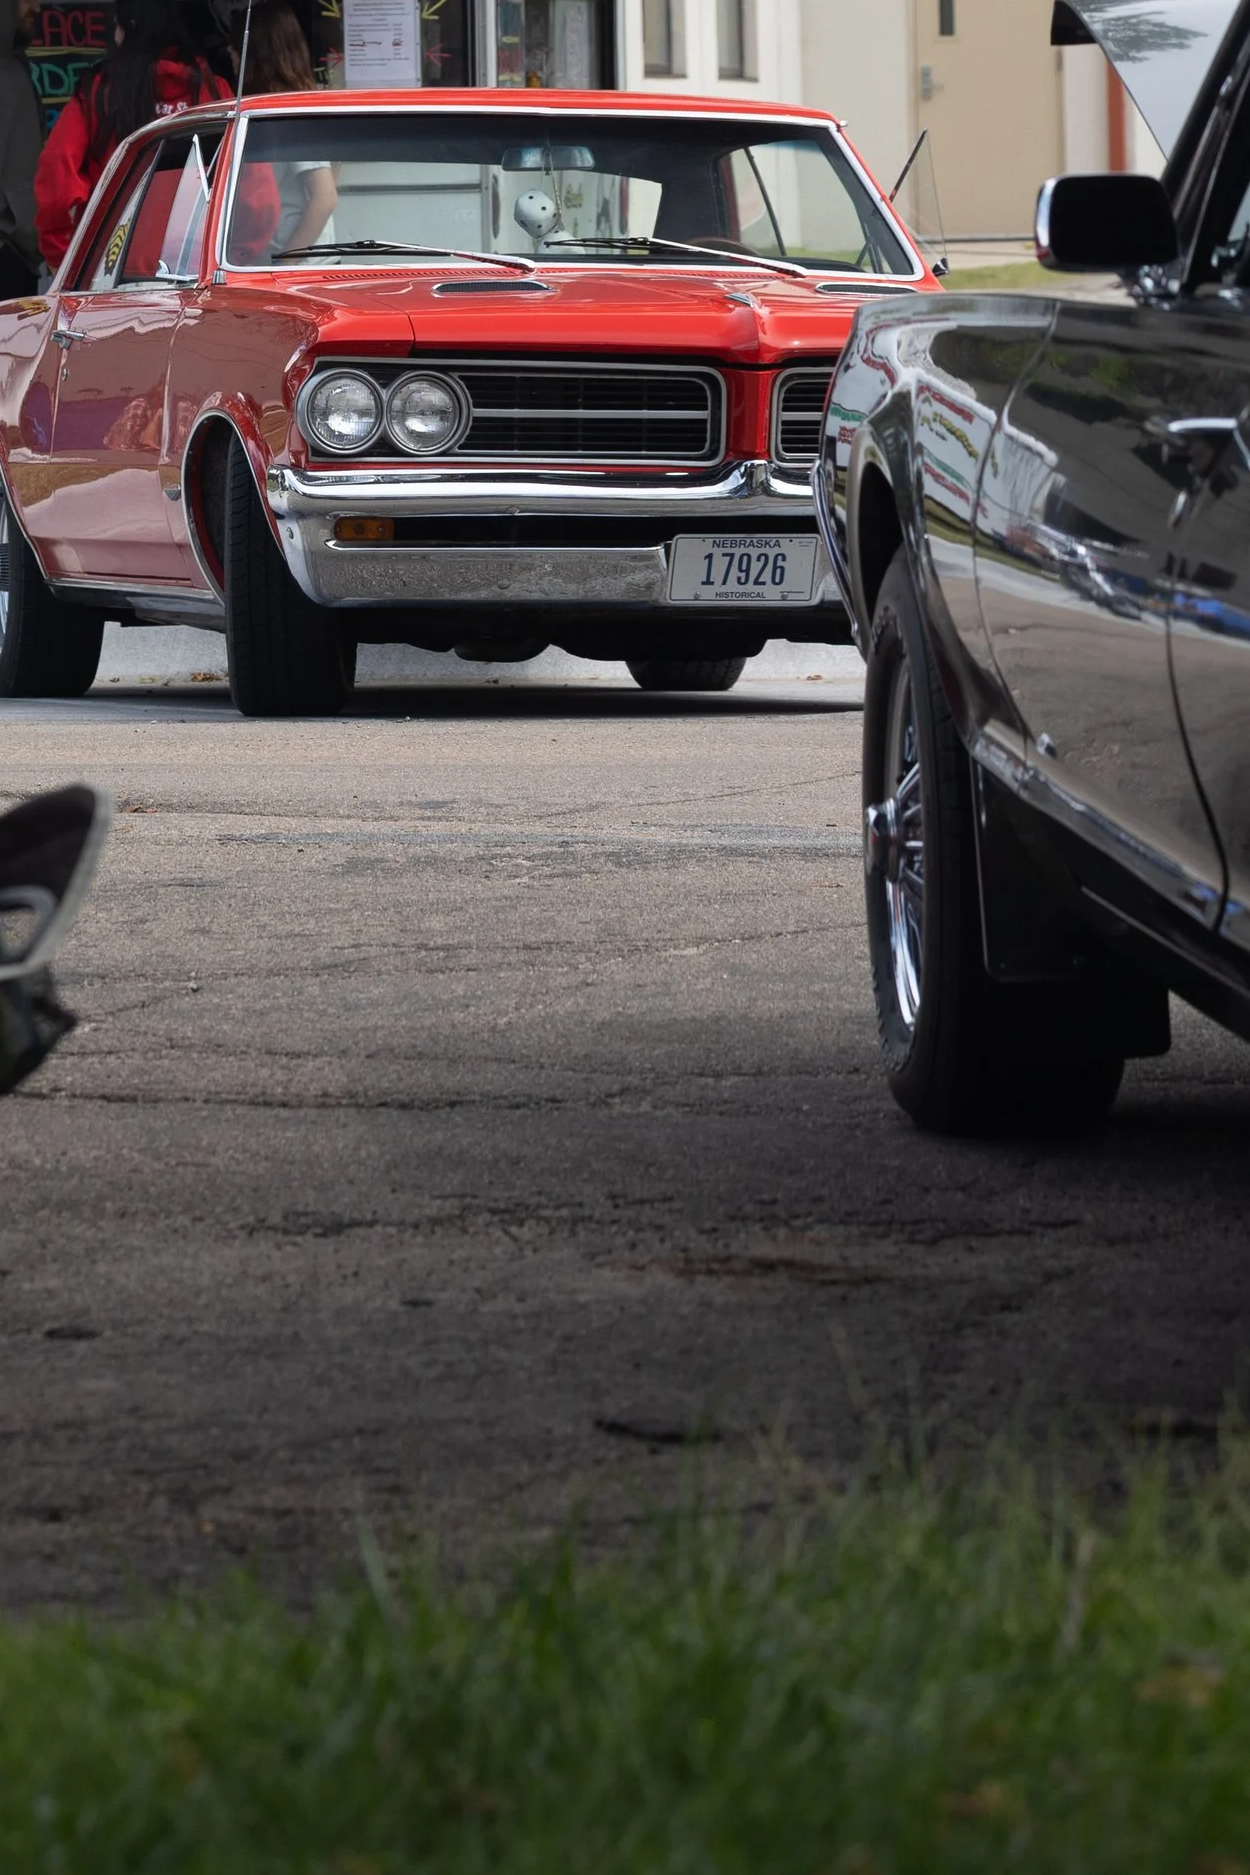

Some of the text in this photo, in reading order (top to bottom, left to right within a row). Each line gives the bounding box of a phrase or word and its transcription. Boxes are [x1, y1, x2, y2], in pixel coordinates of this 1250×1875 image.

[30, 9, 106, 47] ACE
[711, 539, 781, 549] NEBRASKA
[701, 552, 787, 586] 17926
[715, 591, 766, 599] HISTORICAL
